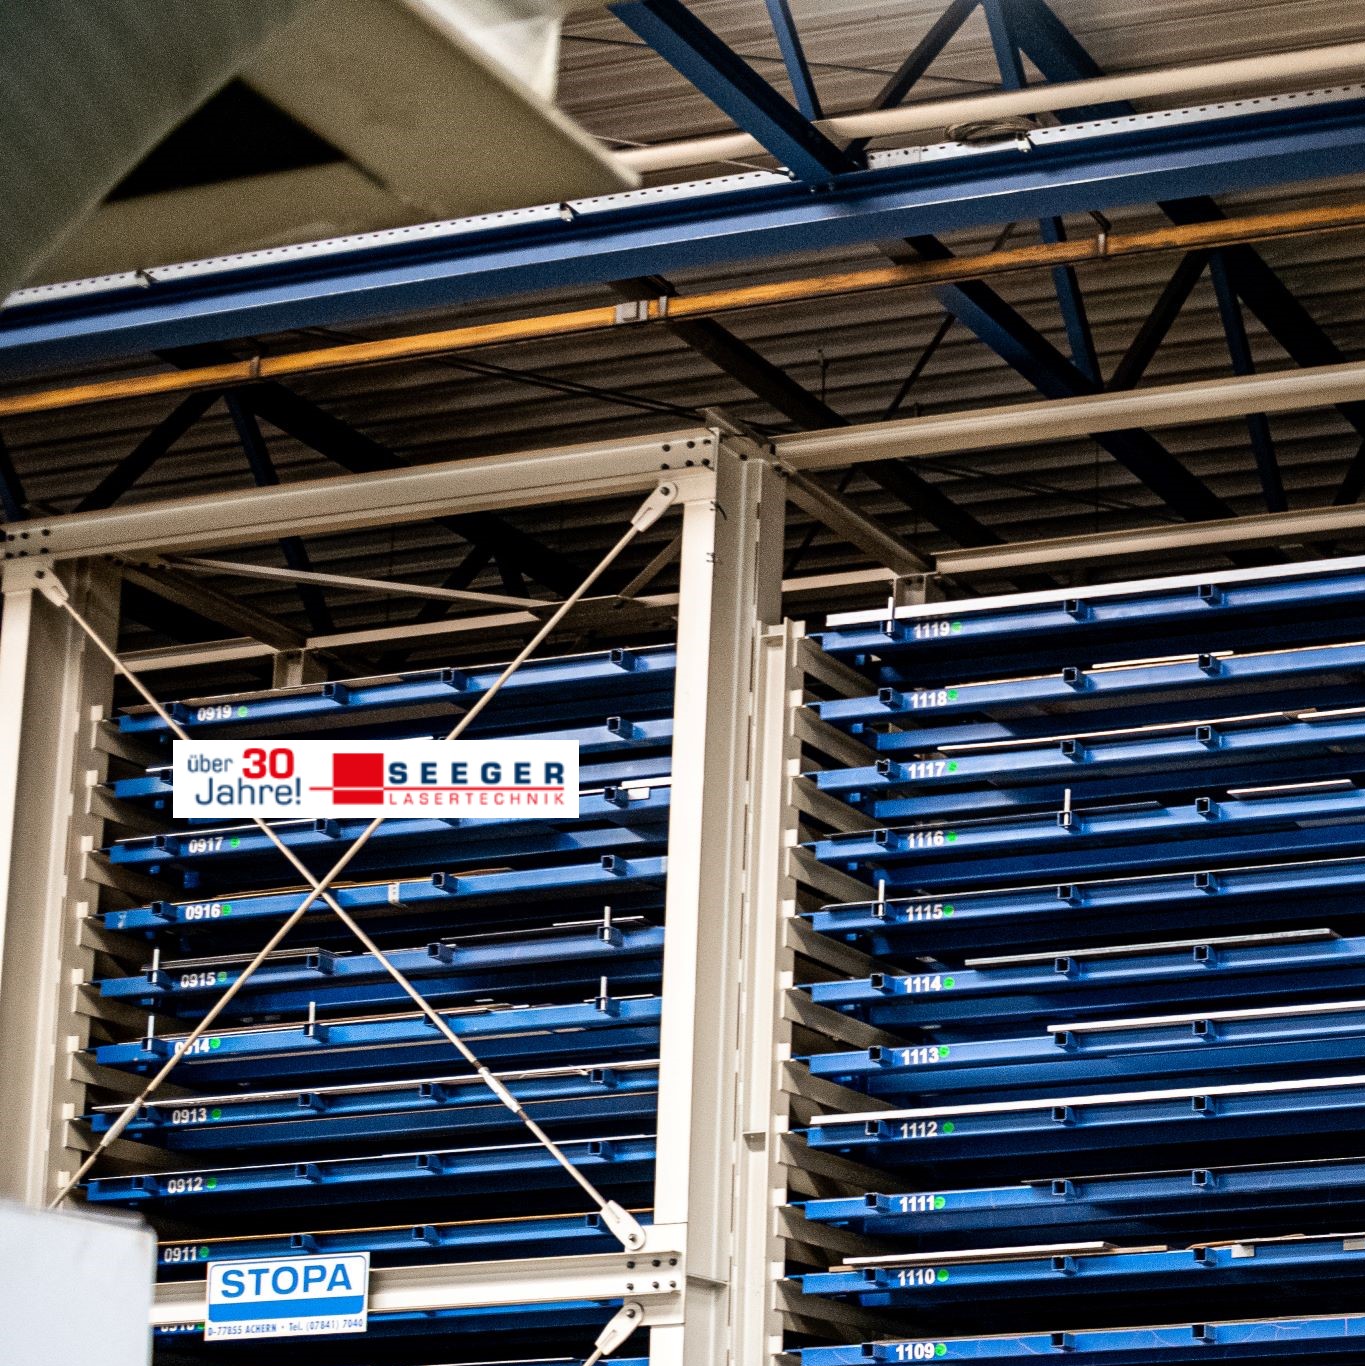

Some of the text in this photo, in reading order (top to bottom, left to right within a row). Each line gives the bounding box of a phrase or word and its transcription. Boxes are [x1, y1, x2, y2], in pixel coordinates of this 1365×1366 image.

[913, 621, 949, 640] 1119
[910, 690, 948, 709] 1118
[197, 704, 232, 721] 0919
[187, 747, 295, 780] über 30
[908, 761, 946, 779] 1117
[388, 762, 564, 785] SEEGER
[195, 777, 301, 805] Jahre!
[389, 793, 564, 805] LASERTECHNIK
[188, 836, 224, 853] 0917
[907, 830, 944, 848] 1116
[185, 904, 221, 920] 0916
[905, 904, 943, 922] 1115
[180, 972, 216, 988] 0915
[903, 975, 942, 993] 1114
[901, 1047, 940, 1066] 1113
[172, 1108, 207, 1124] 0913
[900, 1121, 938, 1139] 1112
[167, 1176, 203, 1194] 0912
[899, 1195, 935, 1212] 1111
[163, 1246, 197, 1263] 0911
[221, 1263, 352, 1299] STOPA
[897, 1268, 936, 1287] 1110
[245, 1323, 277, 1334] ACHERN
[895, 1343, 935, 1361] 1109
